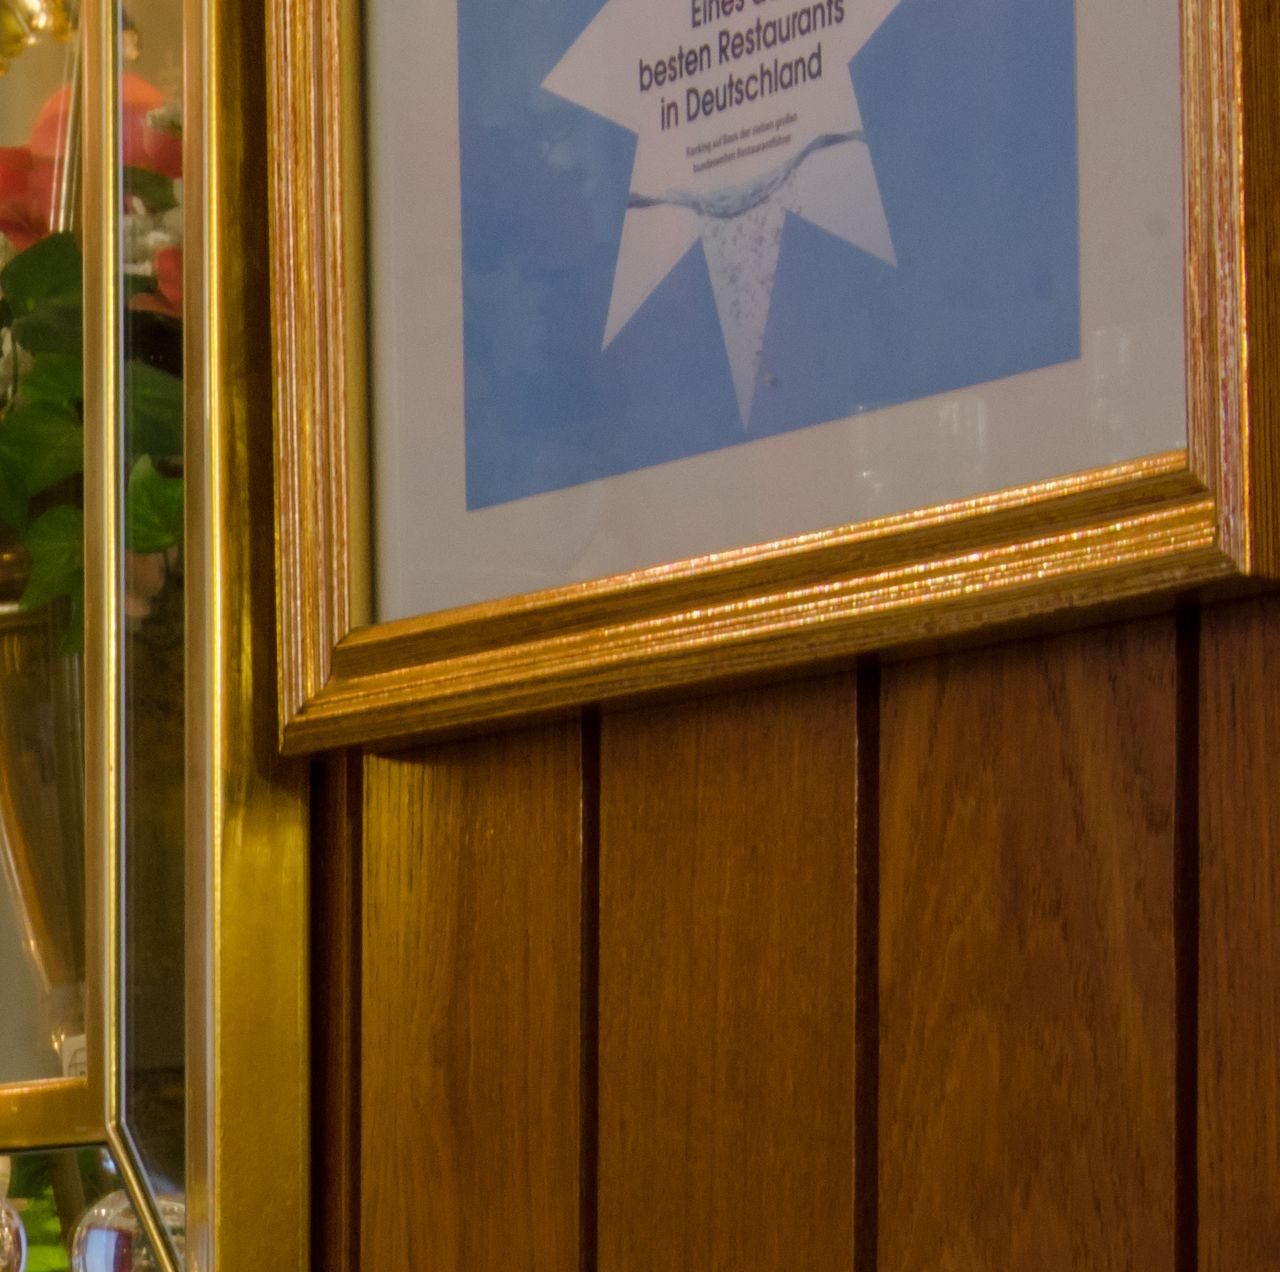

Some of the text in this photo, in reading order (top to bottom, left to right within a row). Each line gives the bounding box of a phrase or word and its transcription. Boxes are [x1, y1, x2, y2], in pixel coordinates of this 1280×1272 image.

[639, 0, 845, 93] besten Restaurants
[660, 42, 822, 131] in Deutschland
